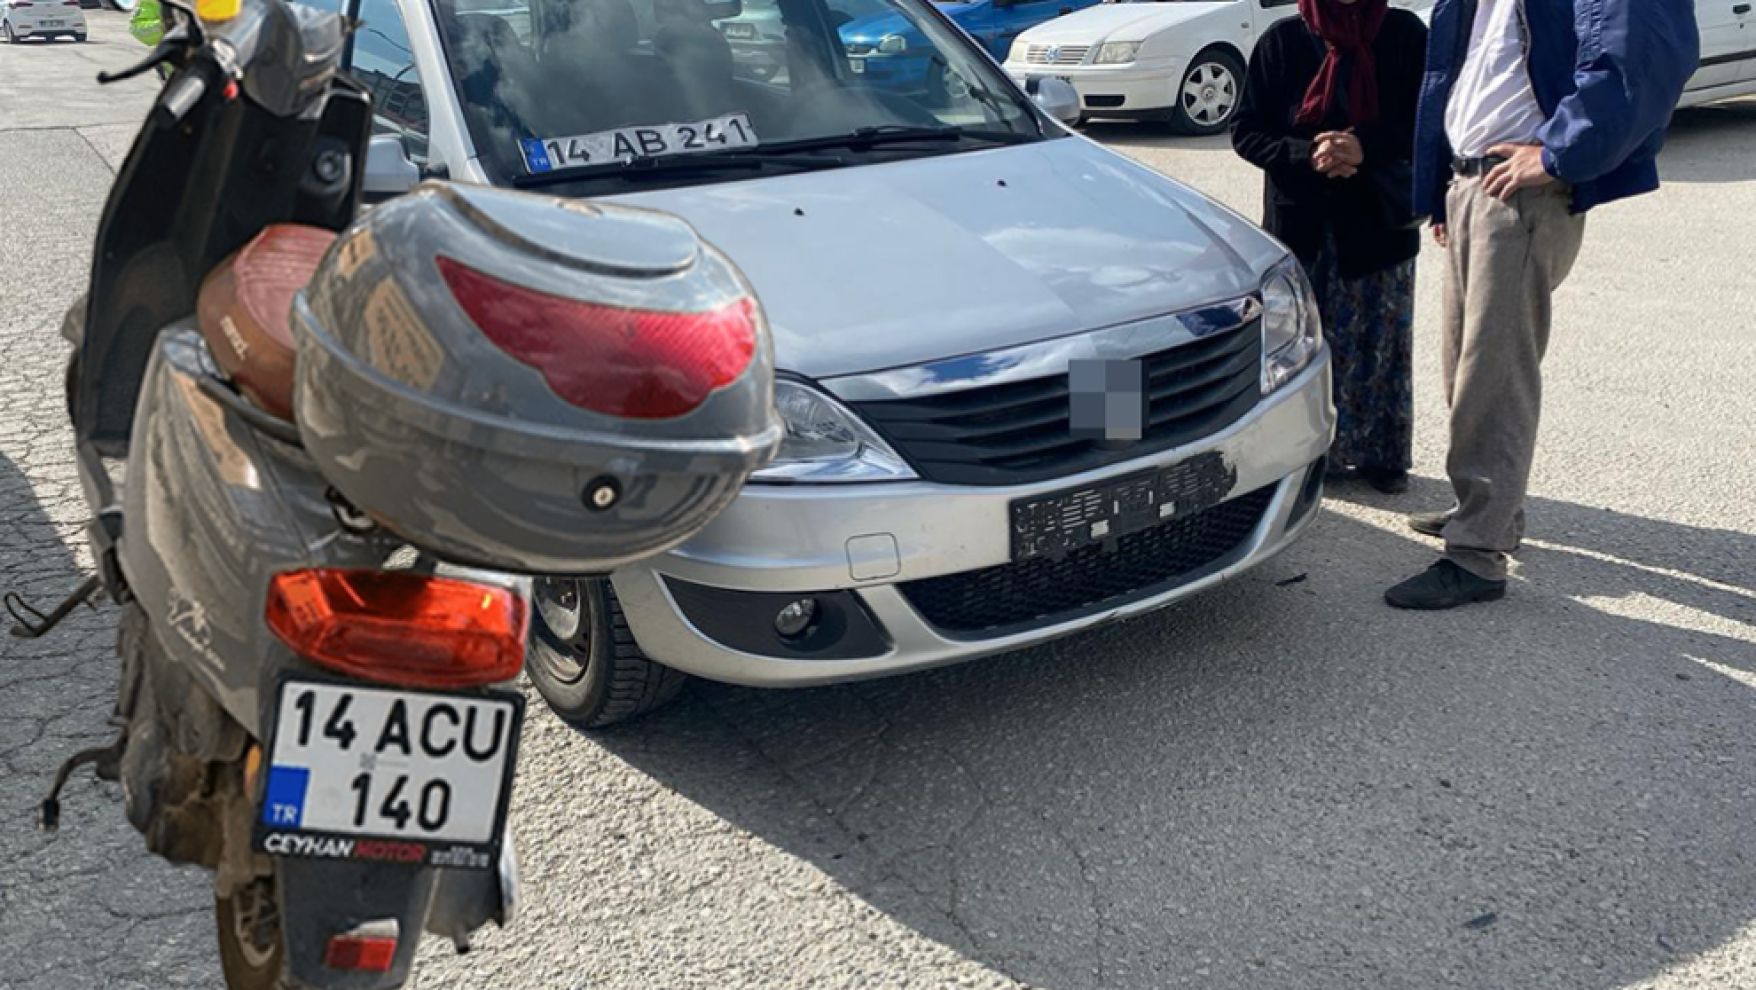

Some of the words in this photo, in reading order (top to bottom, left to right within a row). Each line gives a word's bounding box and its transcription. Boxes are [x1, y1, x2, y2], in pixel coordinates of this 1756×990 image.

[547, 139, 591, 164] 14
[612, 130, 668, 158] AB
[676, 118, 748, 149] 241
[295, 689, 356, 750] 14
[374, 698, 505, 762] ACU
[272, 803, 298, 823] TR
[351, 771, 451, 832] 140
[264, 832, 354, 858] CEYHAN
[353, 839, 427, 862] MOTOR
